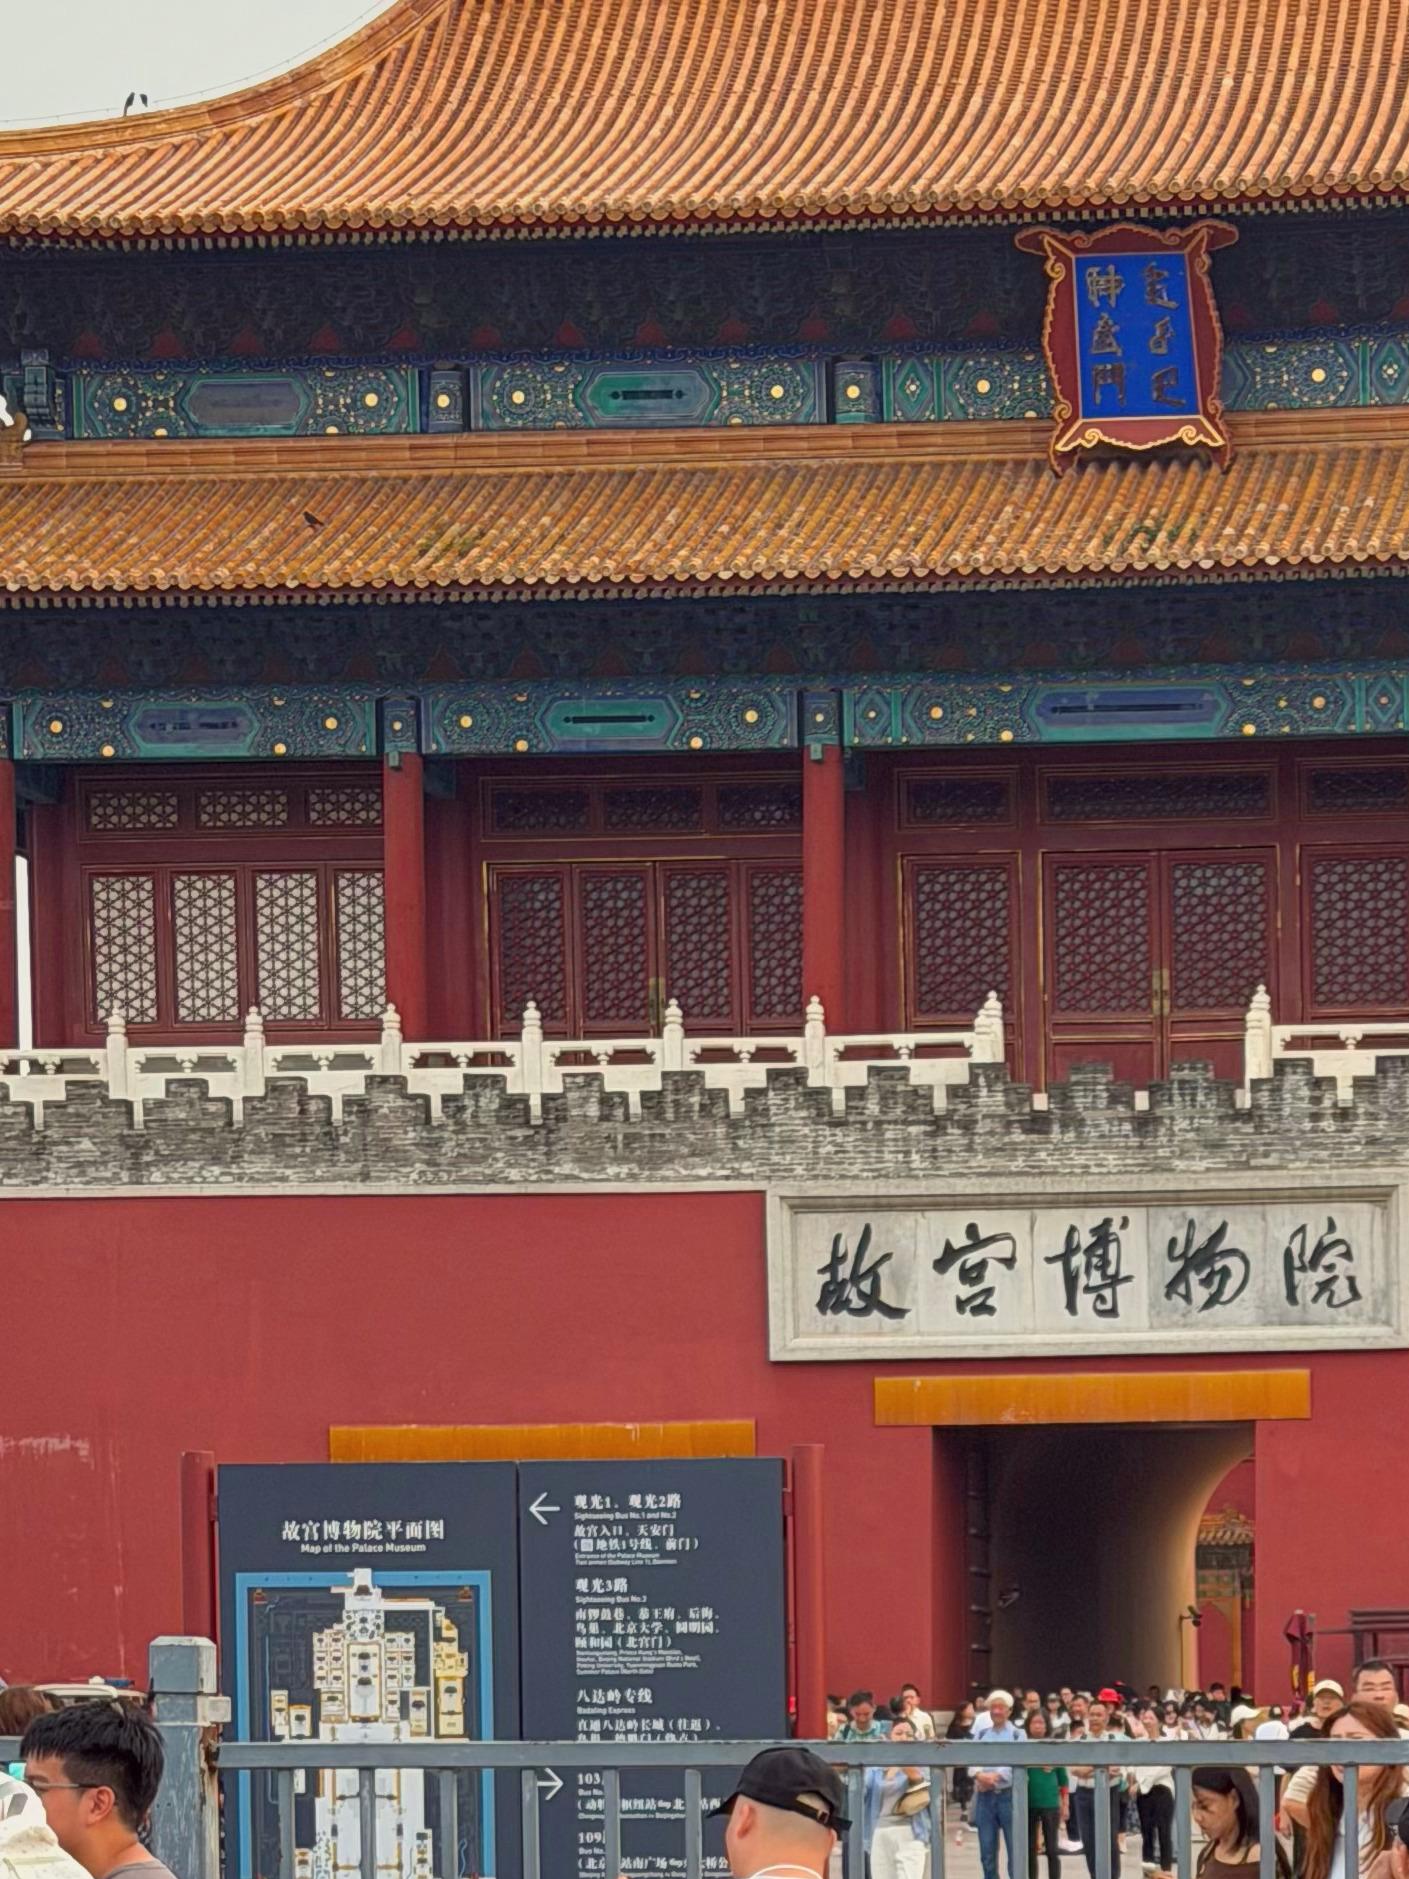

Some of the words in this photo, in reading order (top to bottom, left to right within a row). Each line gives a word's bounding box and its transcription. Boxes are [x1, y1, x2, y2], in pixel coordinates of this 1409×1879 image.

[815, 1215, 1363, 1320] 故宫博物院
[281, 1519, 445, 1541] 故宫博物院平面图
[300, 1543, 321, 1555] Map
[322, 1543, 333, 1553] of
[334, 1543, 350, 1553] the
[352, 1543, 384, 1553] Palace
[385, 1543, 426, 1553] Museum
[577, 1688, 653, 1705] 八达岭专线
[577, 1772, 604, 1785] 103
[578, 1831, 605, 1844] 109
